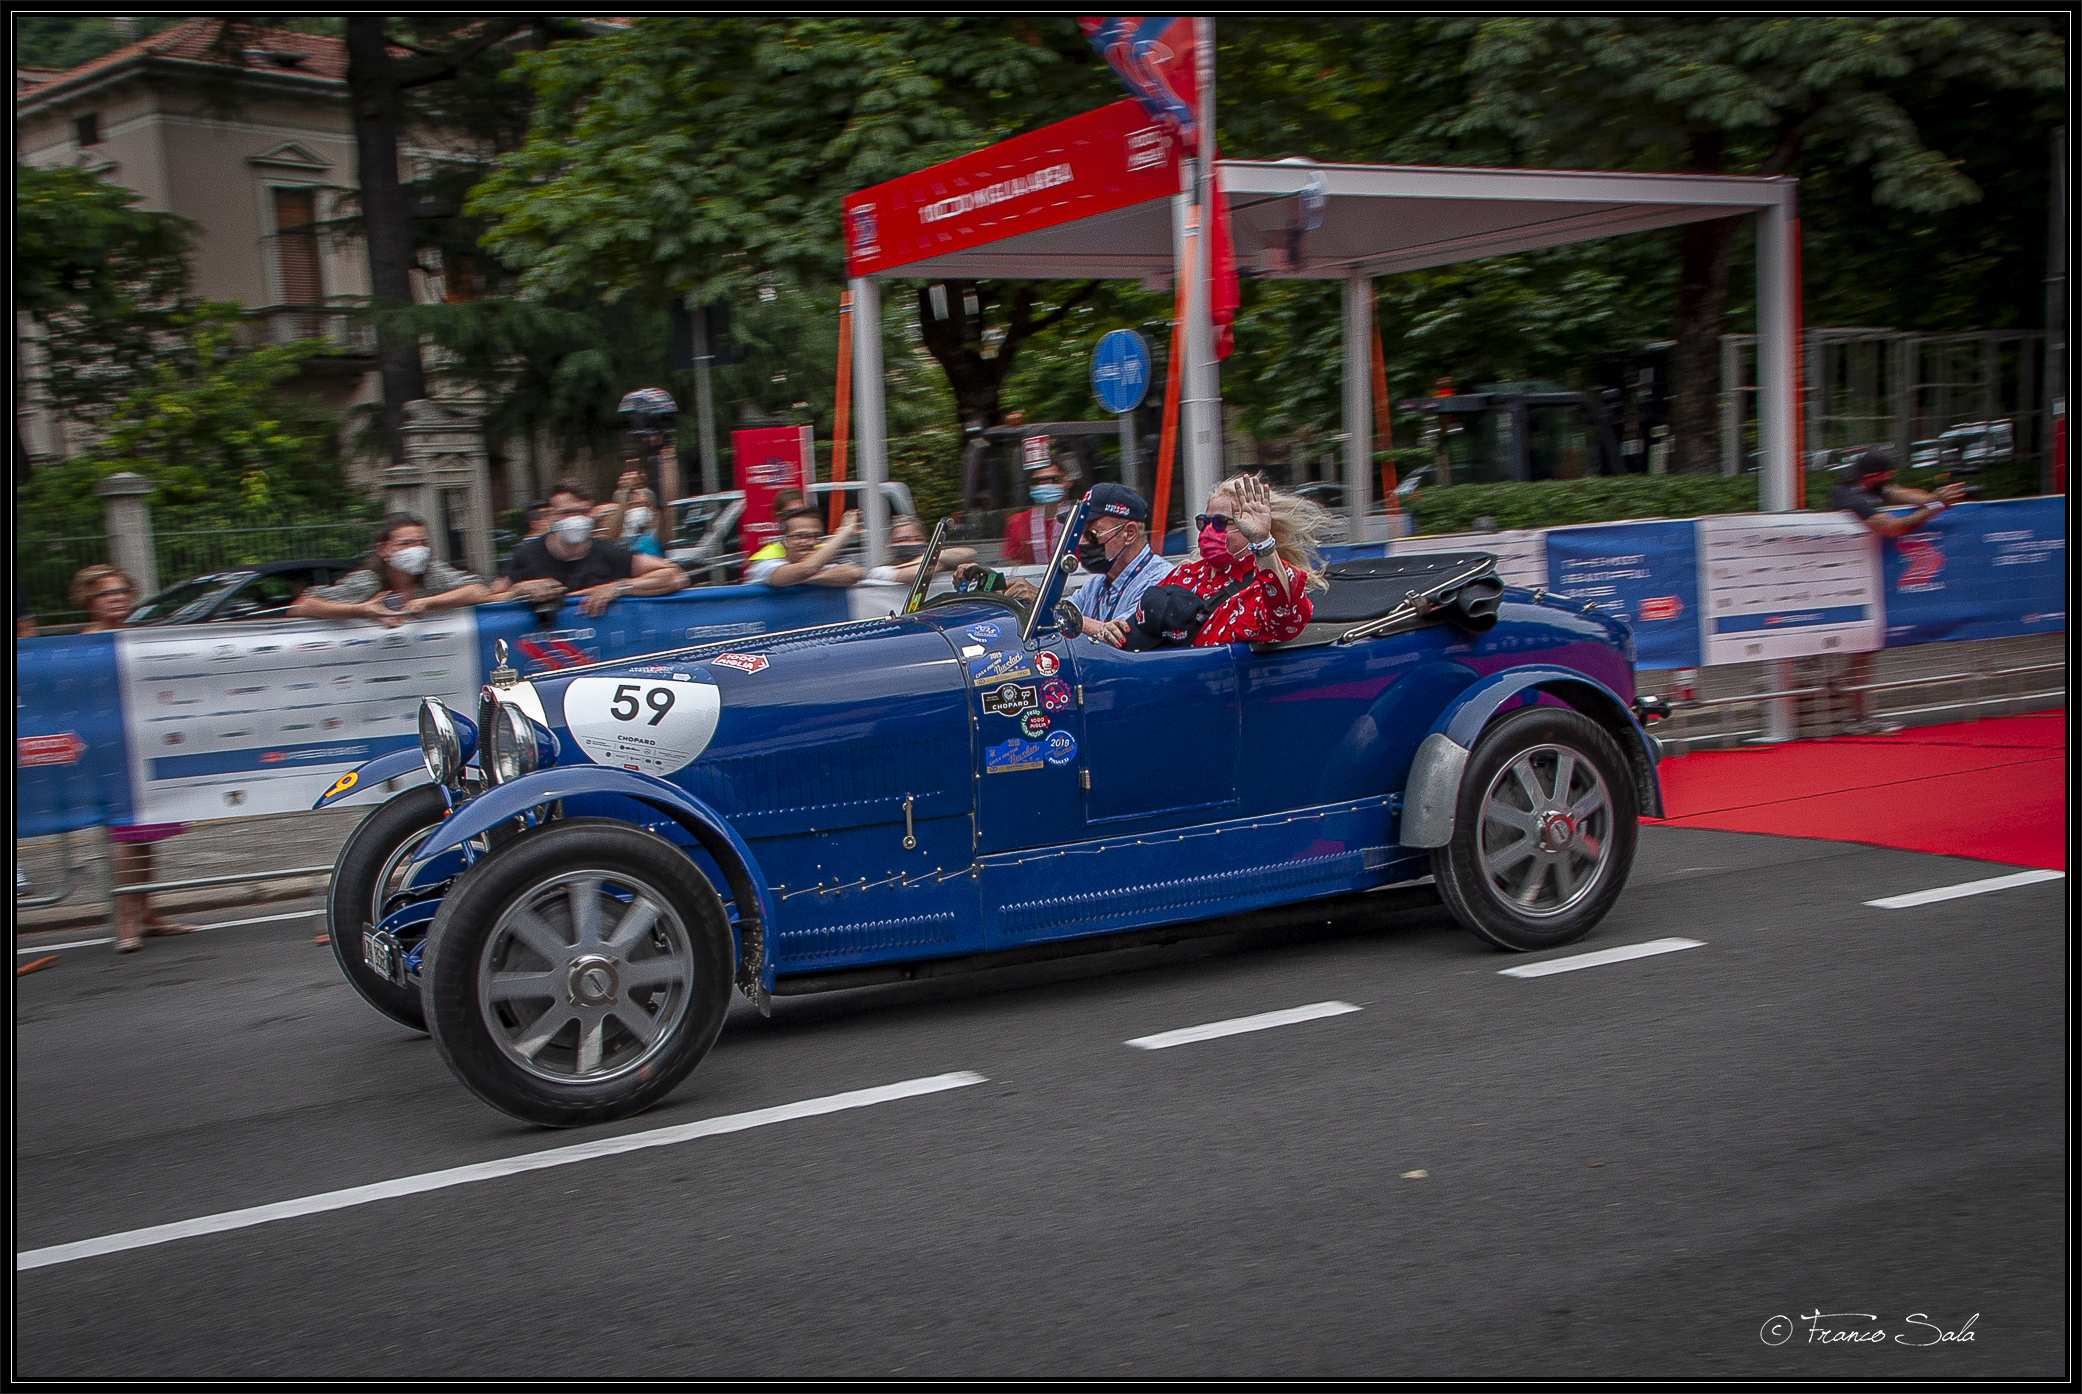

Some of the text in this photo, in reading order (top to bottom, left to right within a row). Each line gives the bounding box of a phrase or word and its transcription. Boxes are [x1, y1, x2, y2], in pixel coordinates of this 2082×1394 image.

[725, 654, 757, 662] 1000
[717, 659, 754, 669] MIGLIA
[610, 684, 676, 727] 59
[992, 700, 1029, 710] CHOPARD
[617, 735, 656, 746] CHOPARD
[1050, 738, 1070, 747] 2018
